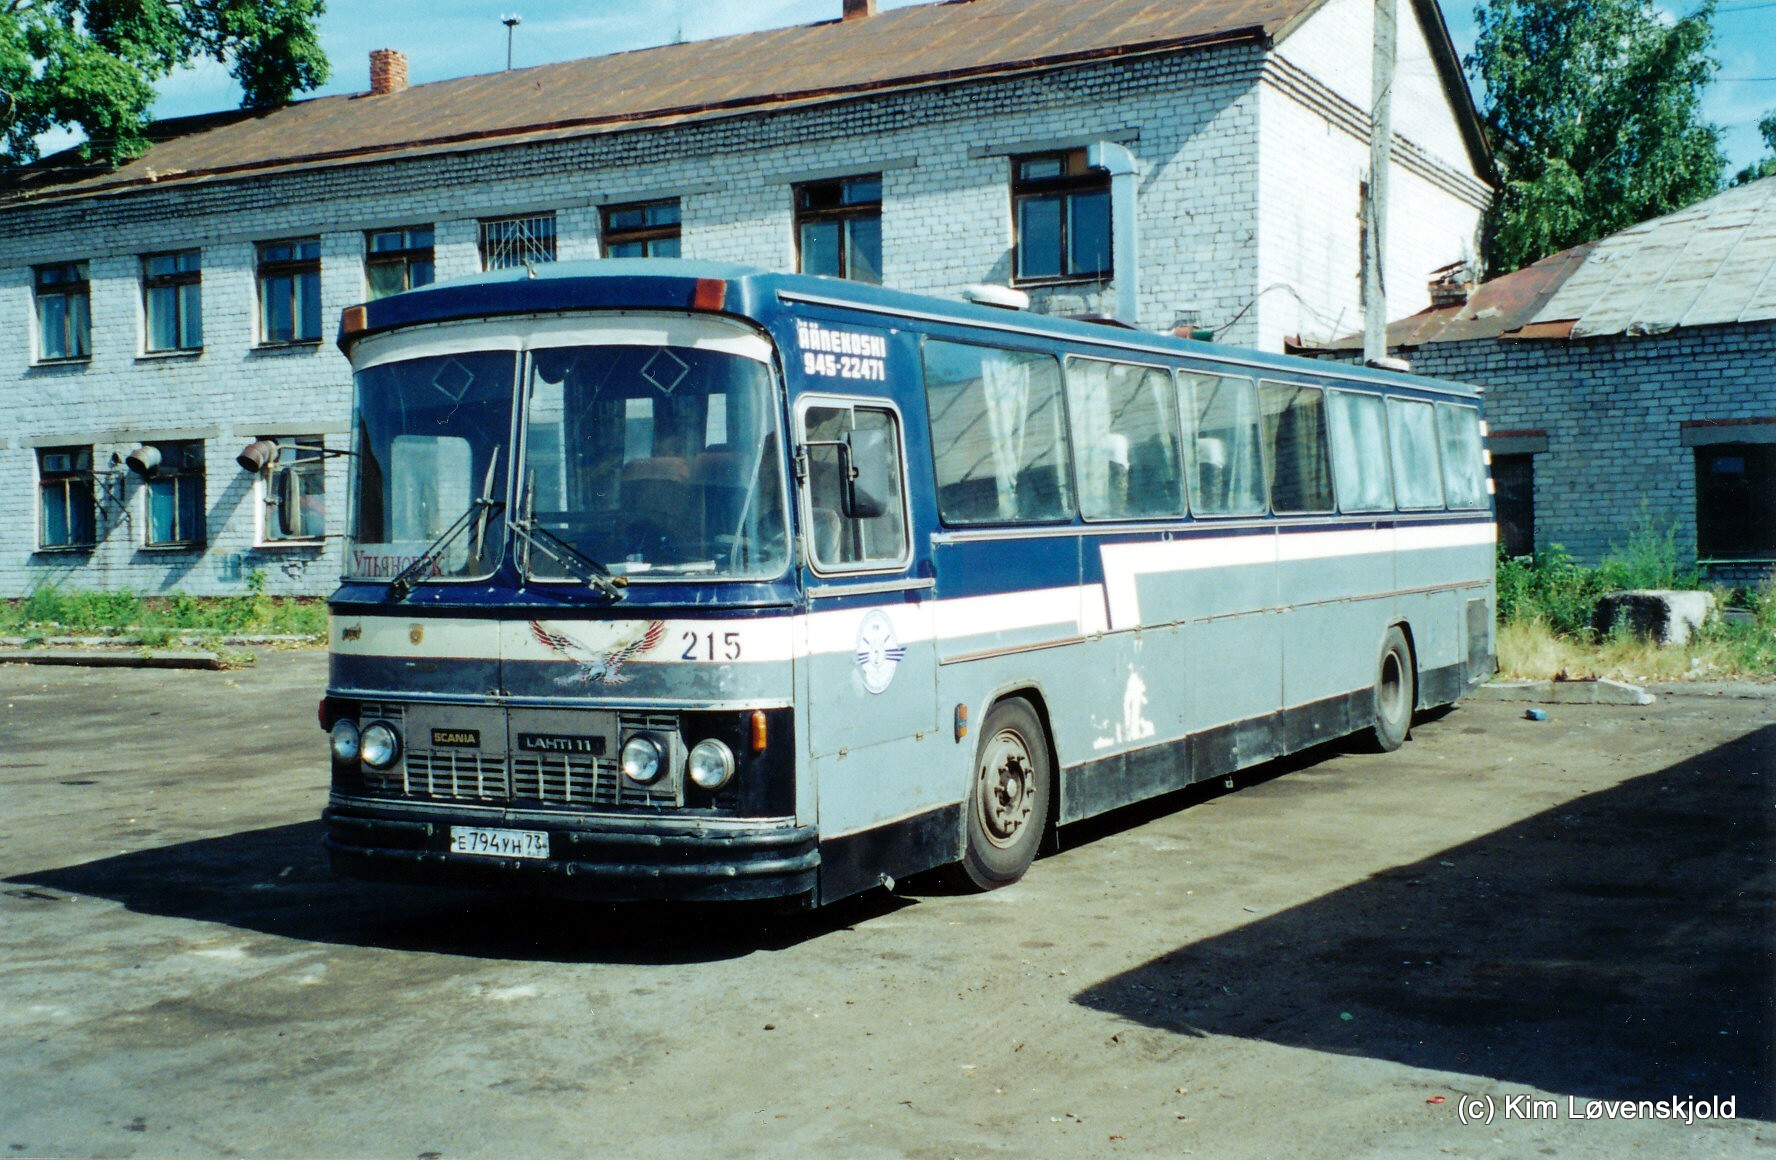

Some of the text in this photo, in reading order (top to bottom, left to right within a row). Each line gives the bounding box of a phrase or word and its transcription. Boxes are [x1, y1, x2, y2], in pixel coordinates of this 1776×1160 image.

[803, 352, 885, 381] 945-22471
[682, 631, 741, 660] 215
[434, 732, 476, 744] SCANIA
[526, 737, 591, 751] LAHTI 11
